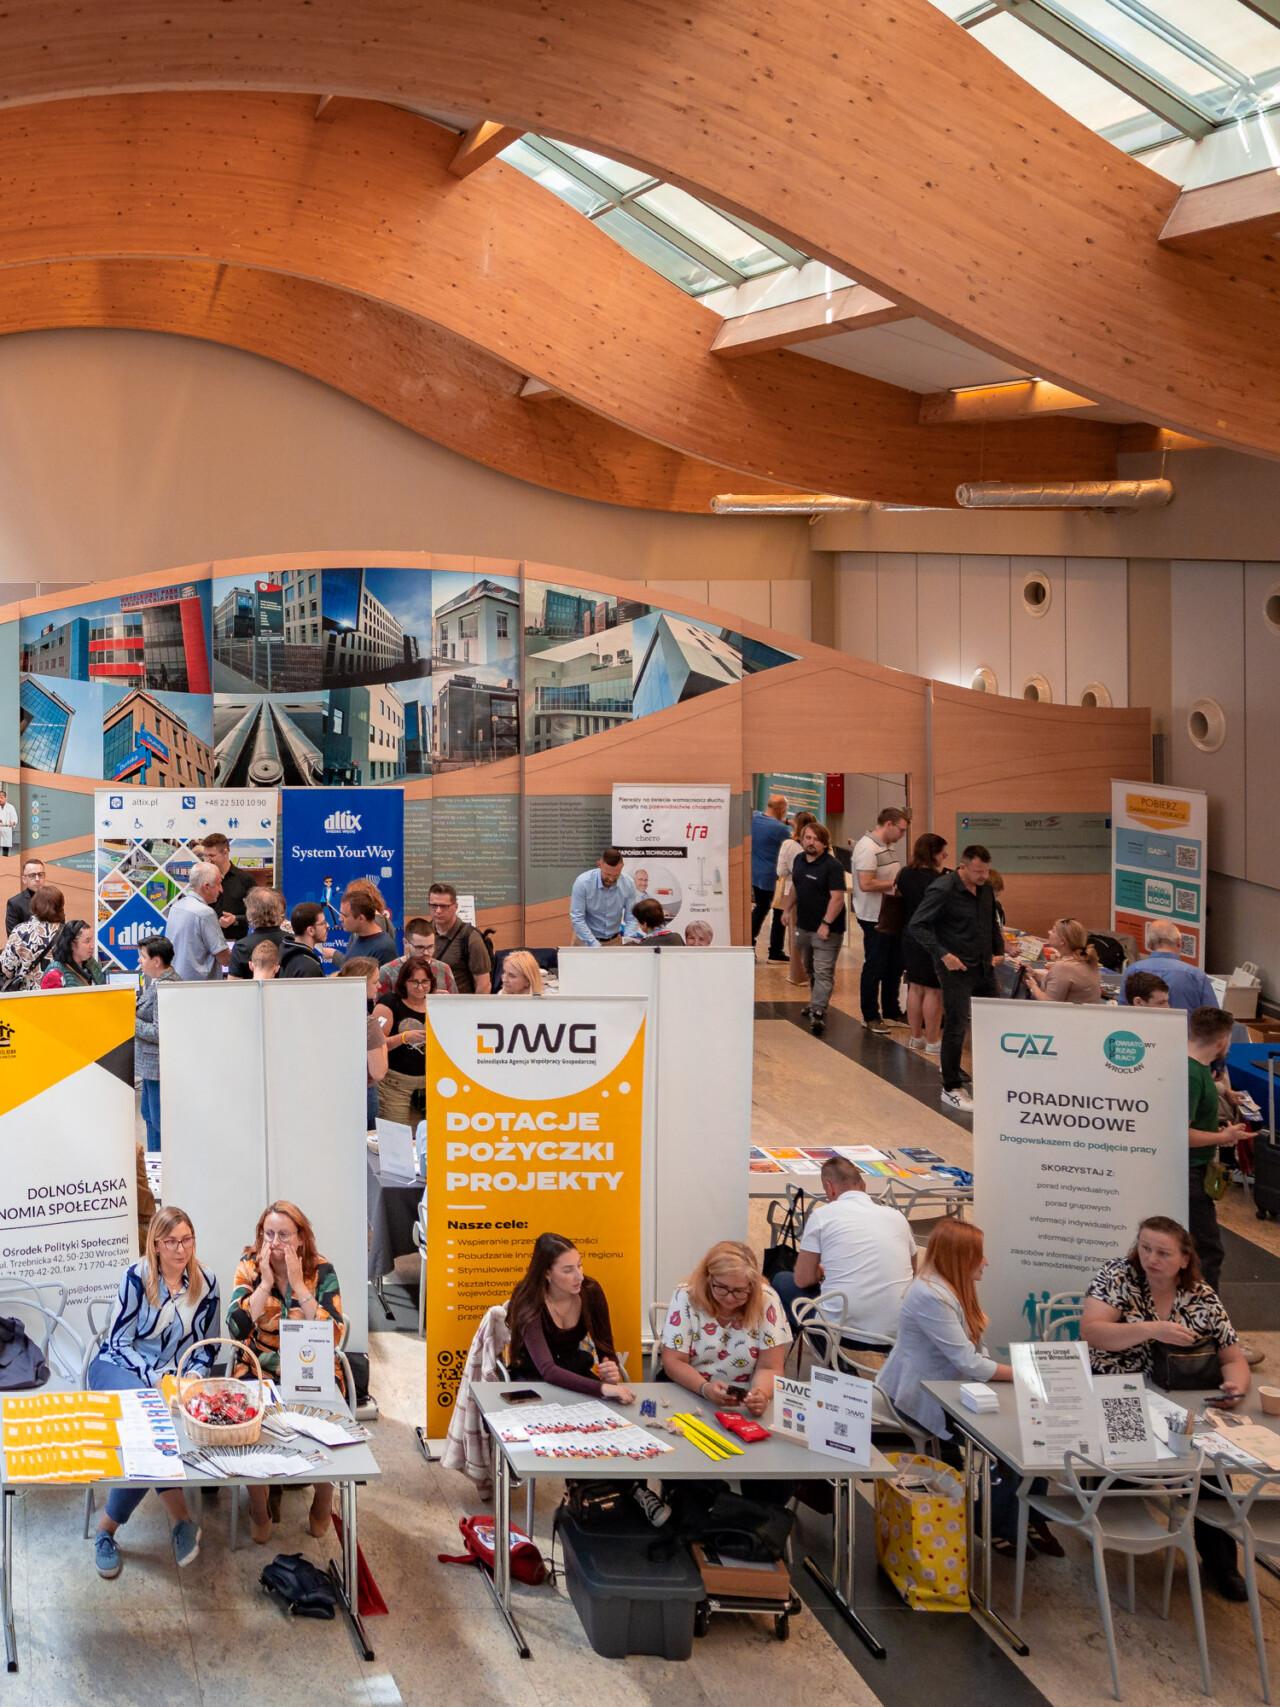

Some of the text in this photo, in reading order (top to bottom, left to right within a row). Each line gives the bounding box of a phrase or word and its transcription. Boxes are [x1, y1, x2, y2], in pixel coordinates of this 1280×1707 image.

[1141, 798, 1177, 811] POBIERZ
[324, 810, 362, 831] altix
[477, 1023, 596, 1054] DAWG
[1001, 1032, 1058, 1058] CAZ
[1109, 1038, 1156, 1048] POWIATOWY
[1109, 1046, 1136, 1054] URZĄD
[1109, 1053, 1136, 1061] PRACY
[562, 1058, 596, 1066] Gospodarczej
[1007, 1090, 1149, 1113] PORADNICTWO
[447, 1112, 600, 1132] DOTACJE
[1020, 1111, 1136, 1132] ZAWODOWE
[447, 1136, 614, 1161] POŻYCZKI
[1000, 1134, 1157, 1155] Drogowskazem do podjęcia pracy
[1041, 1164, 1104, 1176] SKORZYSTAJ
[447, 1171, 624, 1192] PROJEKTY
[28, 1178, 127, 1200] DOLNOŚLĄSKA
[1061, 1184, 1120, 1196] indywidualnych
[48, 1196, 128, 1216] SPOŁECZNA
[1069, 1203, 1111, 1212] grupowych
[448, 1220, 528, 1229] Nasze cele:
[1030, 1216, 1127, 1230] informacji indywidualnych
[3, 1245, 42, 1257] Ośrodek
[44, 1240, 79, 1253] Polityki
[81, 1234, 129, 1249] Społecznej
[458, 1238, 508, 1246] Wspieranie
[1039, 1234, 1119, 1248] informacji grupowych
[10, 1257, 51, 1268] Trzebnicka
[66, 1251, 94, 1261] 50-230
[96, 1248, 129, 1258] Wrocław
[1011, 1248, 1044, 1256] zasobów
[1046, 1252, 1082, 1261] informacji
[63, 1264, 76, 1272] fax.
[79, 1263, 88, 1271] 71
[90, 1257, 130, 1270] 770-42-20
[458, 1266, 523, 1275] Stymulowanie
[1033, 1261, 1090, 1272] samodzielnego
